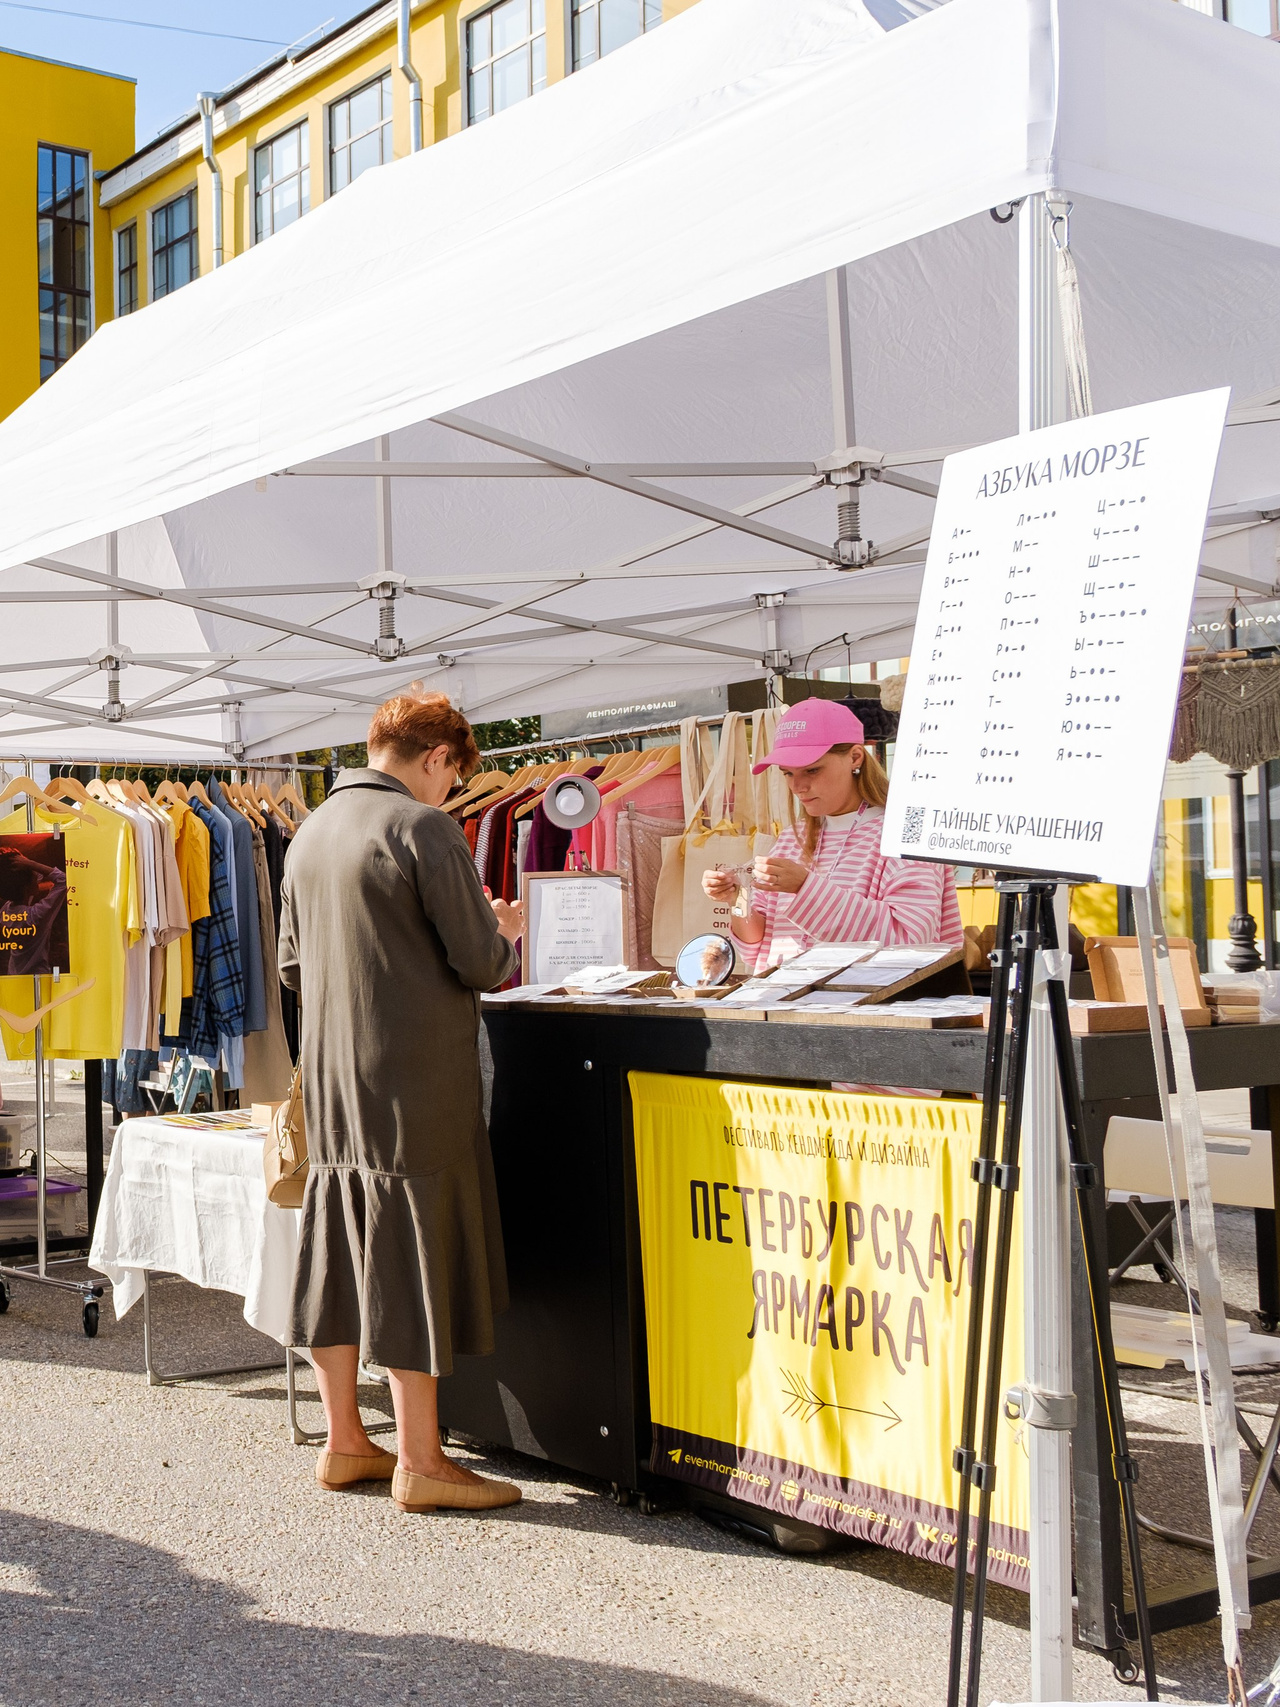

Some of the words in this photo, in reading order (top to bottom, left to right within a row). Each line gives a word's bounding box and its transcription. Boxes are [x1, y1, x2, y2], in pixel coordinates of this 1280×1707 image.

[975, 457, 1053, 500] АЗБУКА
[1059, 437, 1150, 481] МОРЗЕ
[586, 700, 677, 719] ЛЕНПОЛИГРАФМАШ
[932, 807, 992, 833] ТАЙНЫЕ
[995, 814, 1103, 842] УКРАШЕНИЯ
[927, 832, 1012, 855] @braslet.morse
[2, 910, 28, 922] best
[2, 924, 37, 939] (your)
[723, 1125, 785, 1152] ФЕСТИВАЛЬ
[786, 1133, 854, 1162] ХЕНДМЕЙДА
[857, 1141, 868, 1161] И
[870, 1141, 930, 1168] ДИЗАЙНА
[690, 1179, 974, 1297] ПЕТЕРБУРСКАЯ
[747, 1269, 930, 1375] ЯРМАРКА
[684, 1452, 771, 1488] eventhandmade
[803, 1488, 903, 1530] handmadefest.ru
